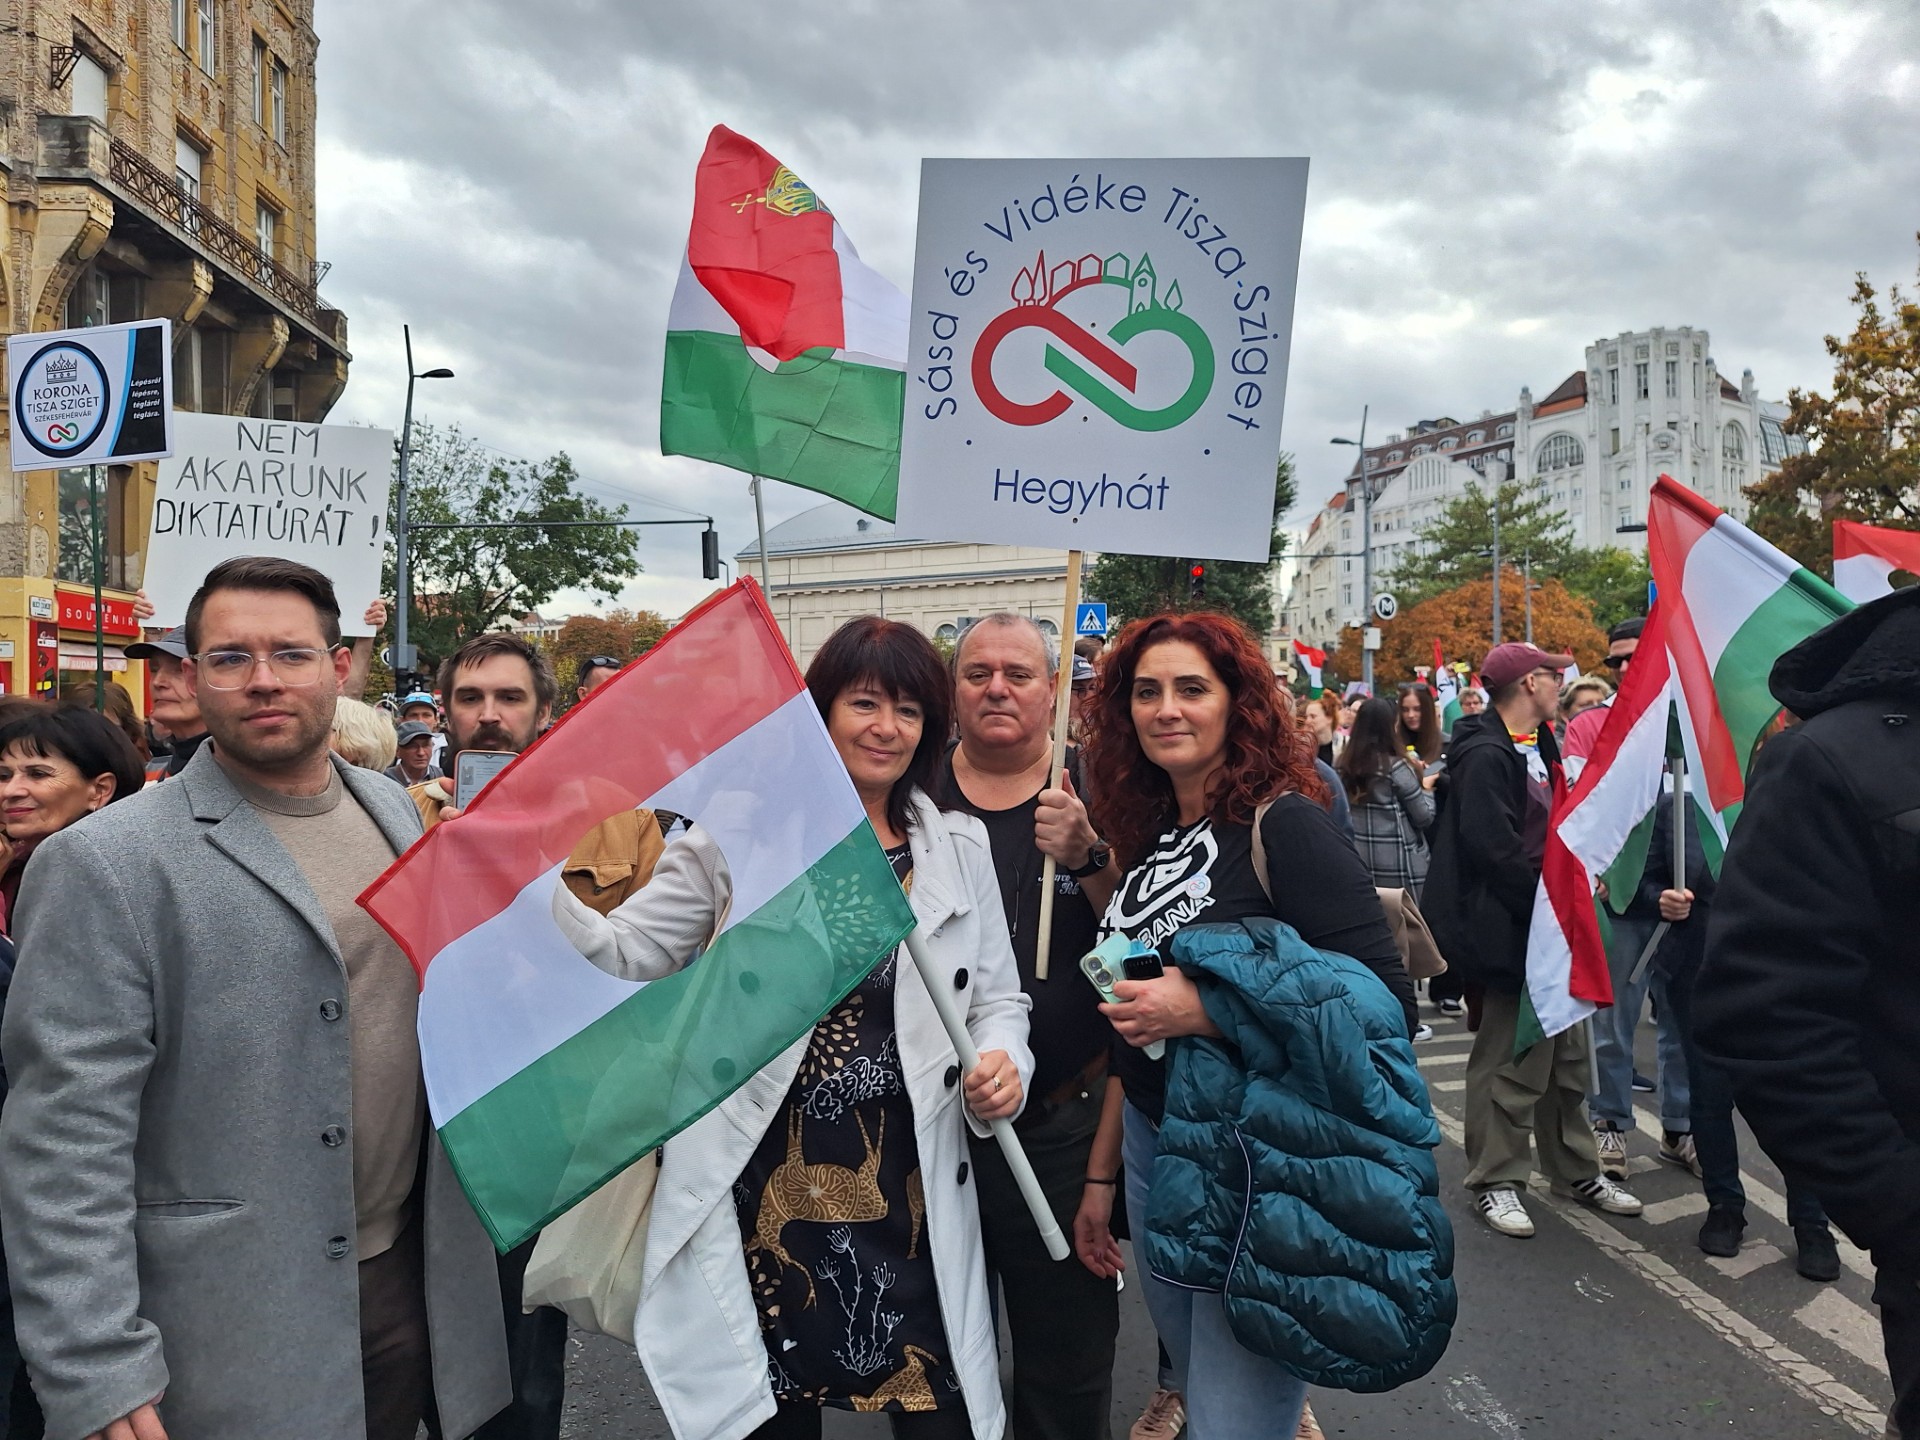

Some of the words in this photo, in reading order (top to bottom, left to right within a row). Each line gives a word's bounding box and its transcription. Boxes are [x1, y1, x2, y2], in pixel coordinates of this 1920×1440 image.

[918, 310, 959, 420] Sásd
[944, 250, 989, 297] és
[983, 173, 1147, 243] Vidéke
[1163, 187, 1280, 431] Tisza-Sziget
[26, 401, 57, 414] TISZA
[60, 396, 100, 411] SZIGET
[34, 384, 90, 400] KORONA
[34, 411, 92, 422] SZÉKESFEHÉRVÁR
[237, 421, 320, 458] NEM
[175, 456, 368, 504] AKARUNK
[993, 468, 1170, 515] Hegyhát
[155, 498, 354, 546] DIKTATÚRÁT
[66, 607, 133, 626] SOUENIR
[1131, 895, 1216, 952] BANA
